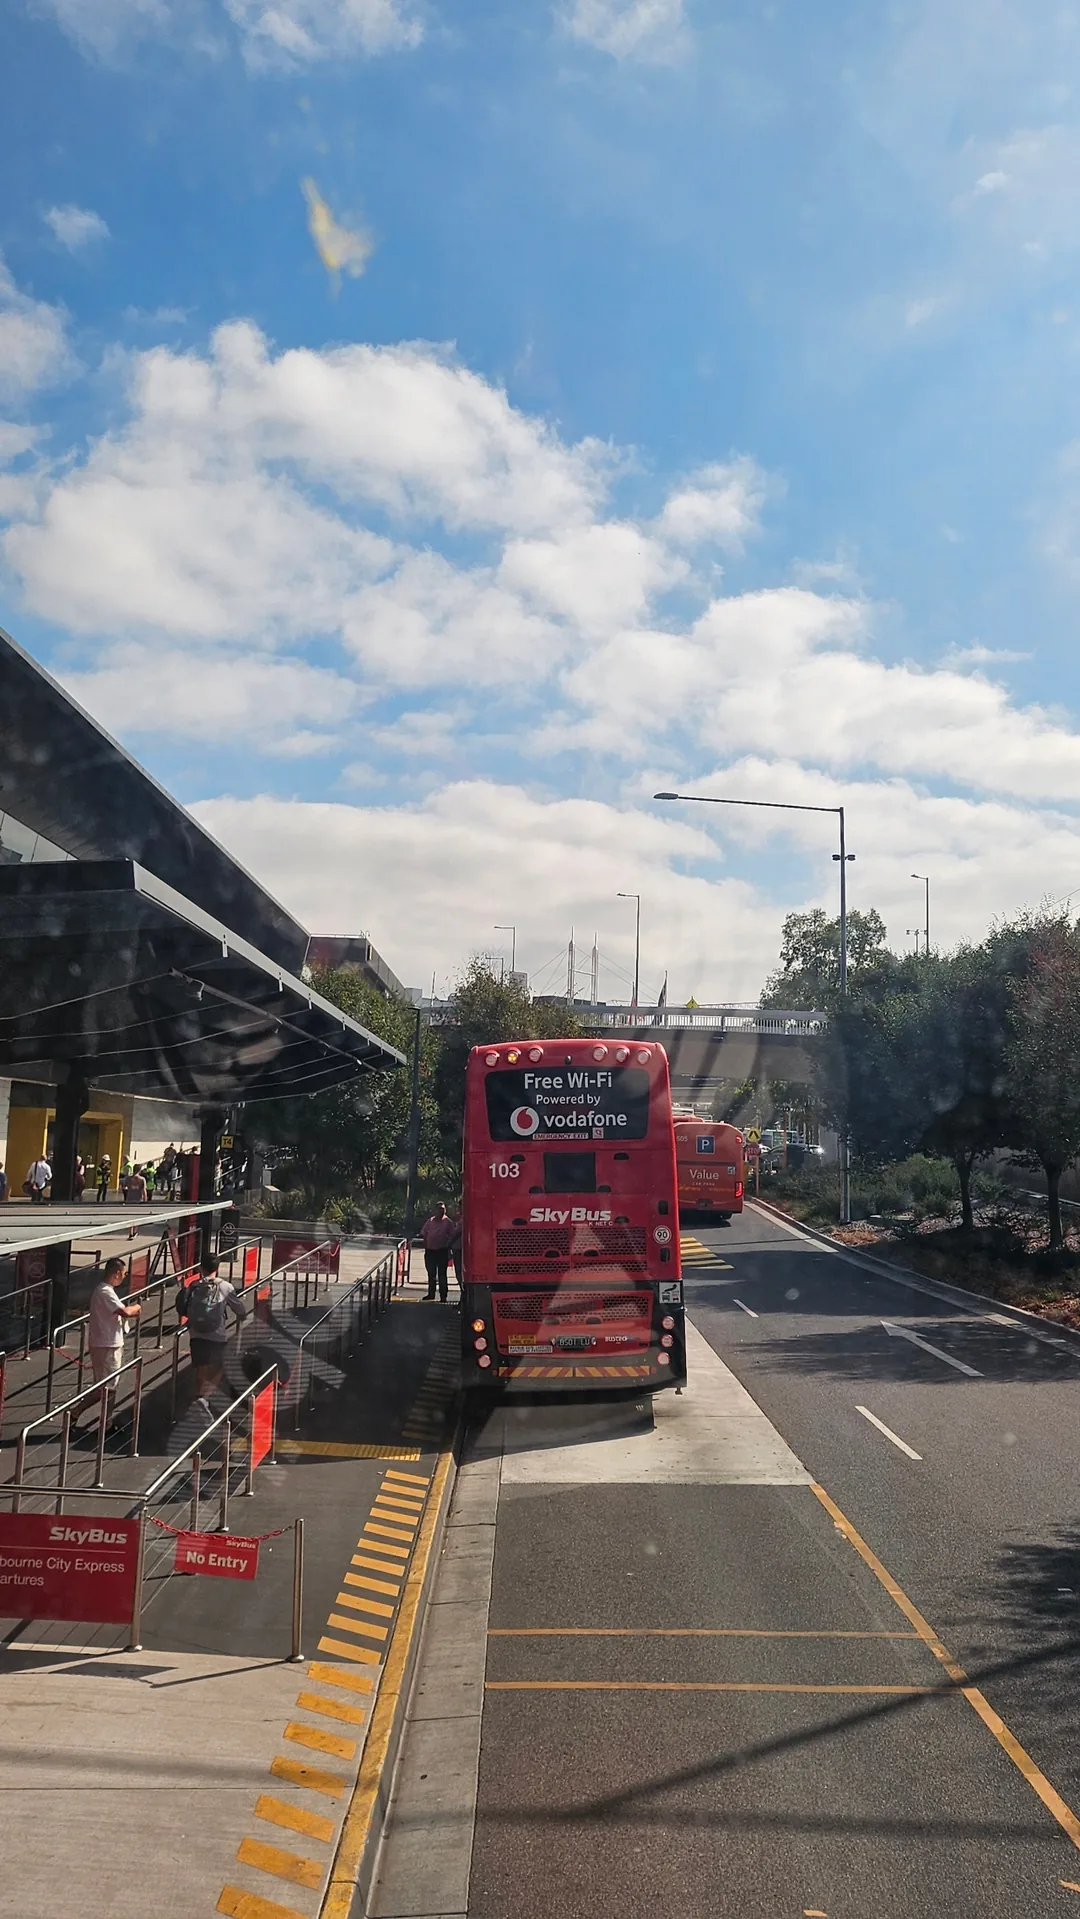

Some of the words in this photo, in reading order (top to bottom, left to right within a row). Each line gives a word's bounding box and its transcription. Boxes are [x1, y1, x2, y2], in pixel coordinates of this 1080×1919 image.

[524, 1073, 563, 1089] Free
[567, 1072, 612, 1088] Wi-Fi
[536, 1094, 584, 1104] Powered
[587, 1094, 601, 1106] by
[544, 1111, 627, 1127] vodafone
[701, 1139, 710, 1150] P
[489, 1163, 520, 1178] 103
[689, 1169, 719, 1180] Value
[530, 1207, 611, 1224] SkyBus
[657, 1231, 668, 1239] 90
[49, 1526, 127, 1544] SkyBus
[226, 1540, 256, 1549] SkyBus
[46, 1557, 71, 1573] City
[75, 1558, 125, 1574] Express
[186, 1551, 205, 1565] No
[208, 1553, 248, 1572] Entry
